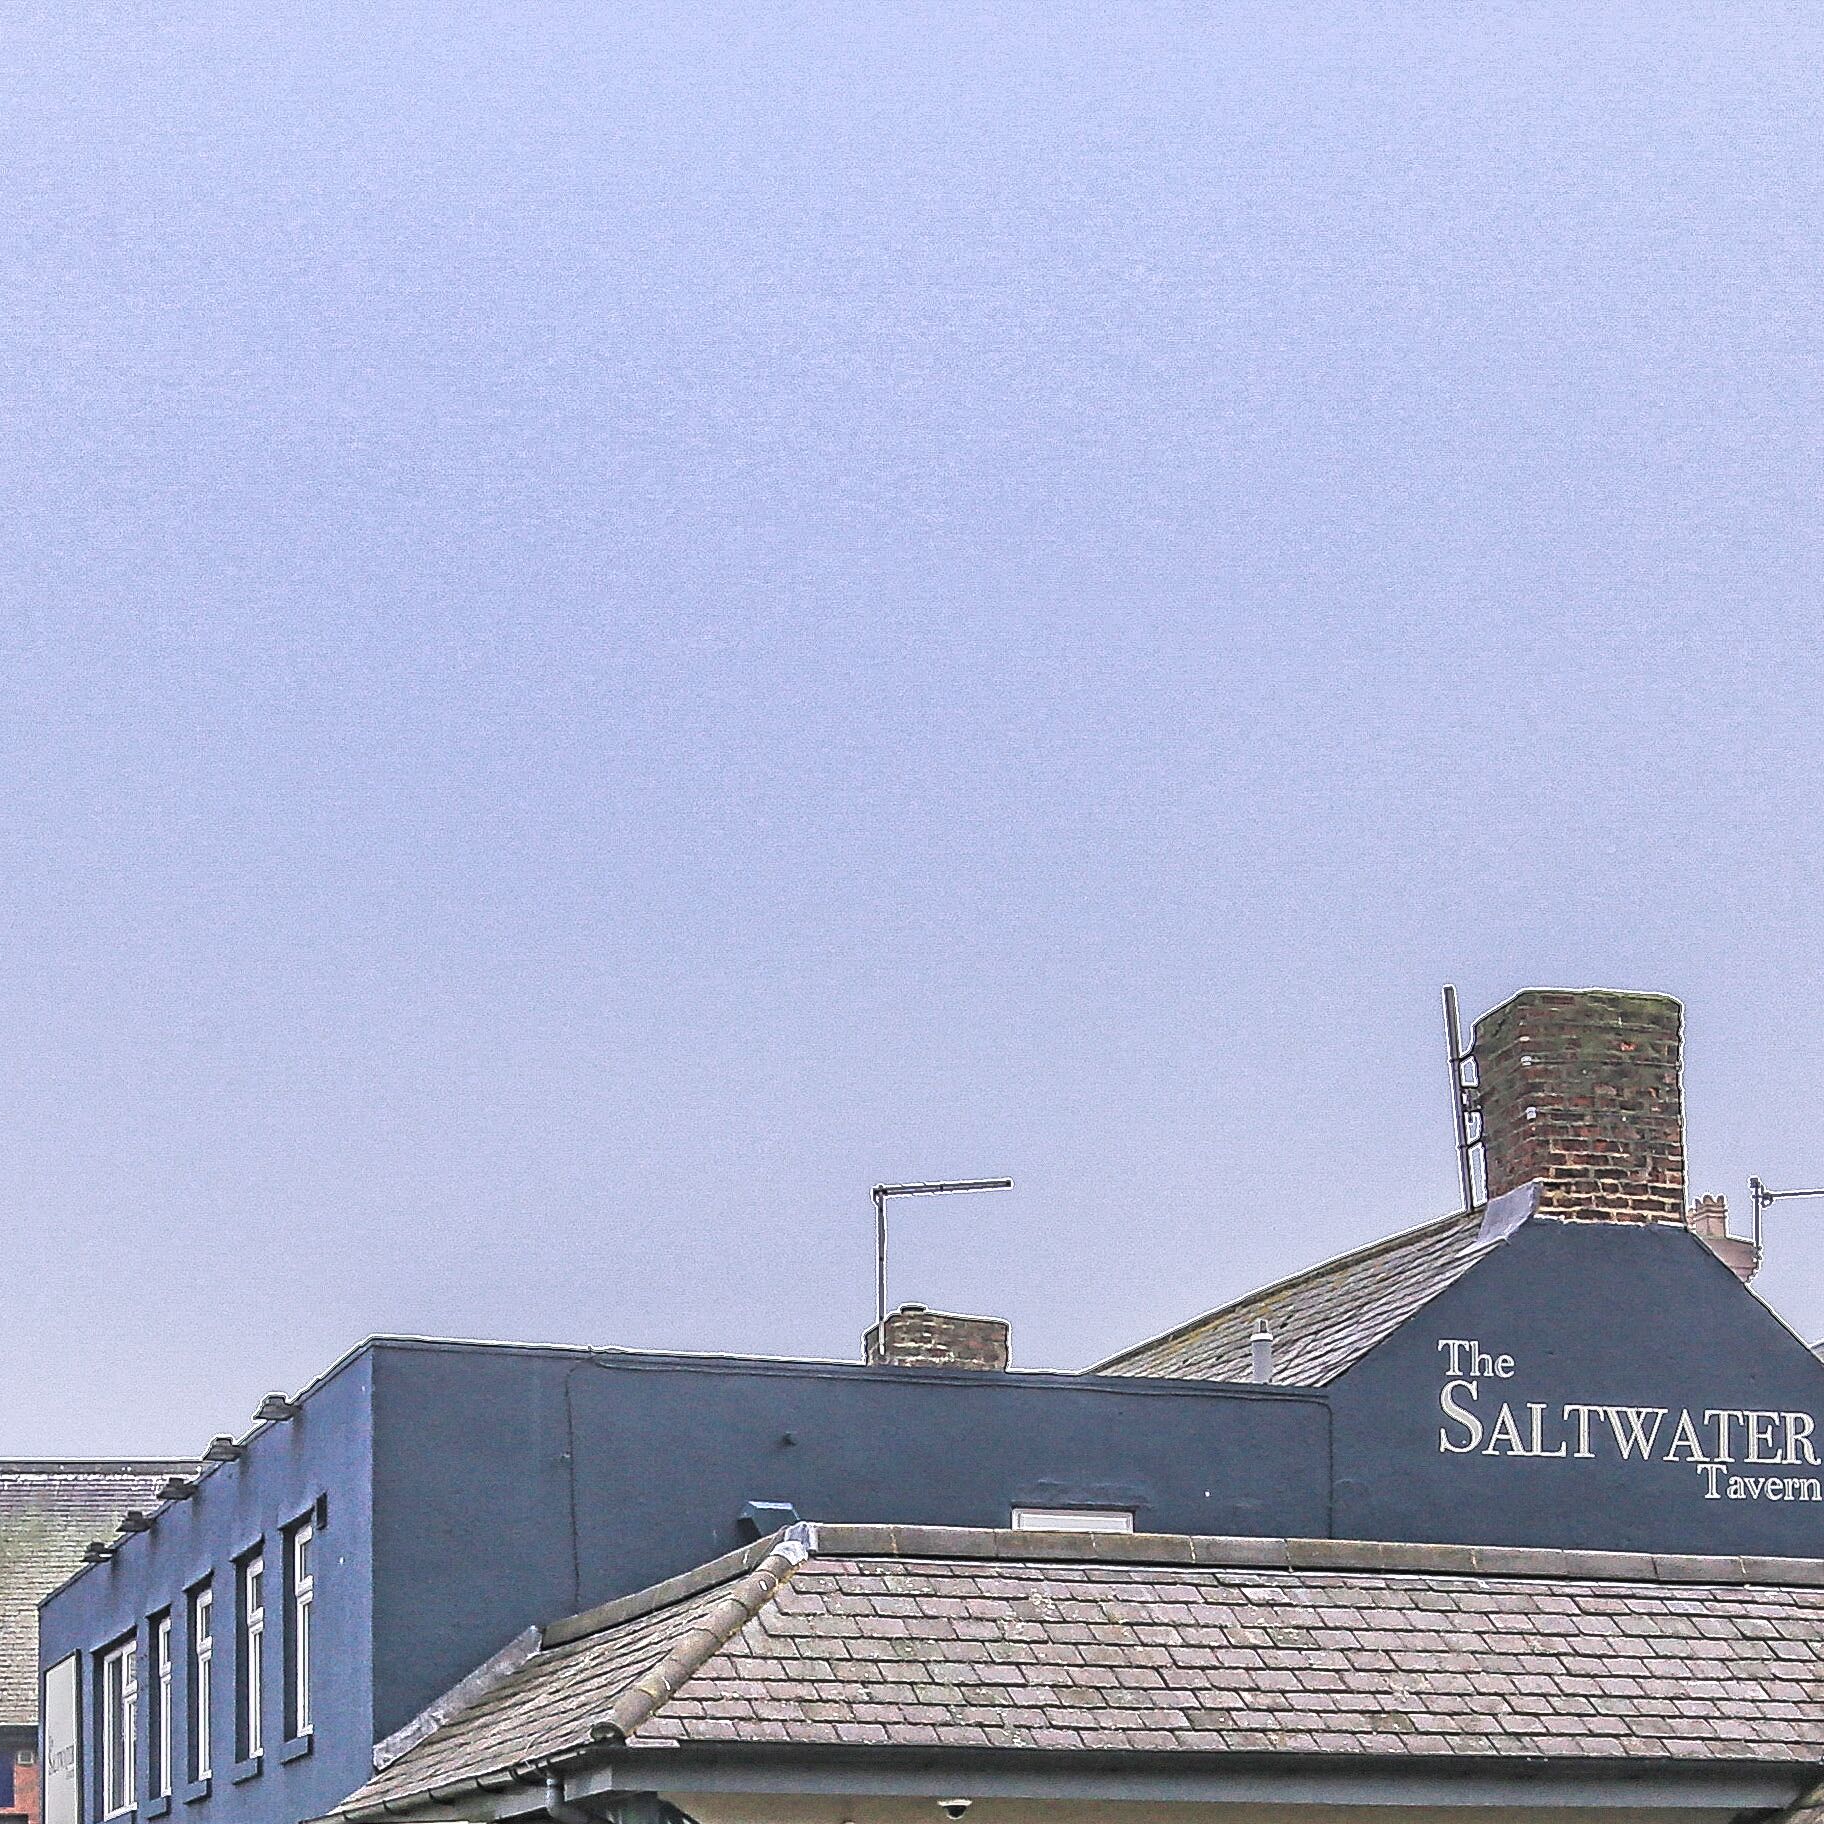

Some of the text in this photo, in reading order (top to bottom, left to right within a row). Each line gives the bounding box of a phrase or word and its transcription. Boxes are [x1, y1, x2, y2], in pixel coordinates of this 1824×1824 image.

[1438, 1339, 1515, 1378] The
[1439, 1379, 1822, 1465] SALTWATER
[1696, 1462, 1823, 1501] Tavern
